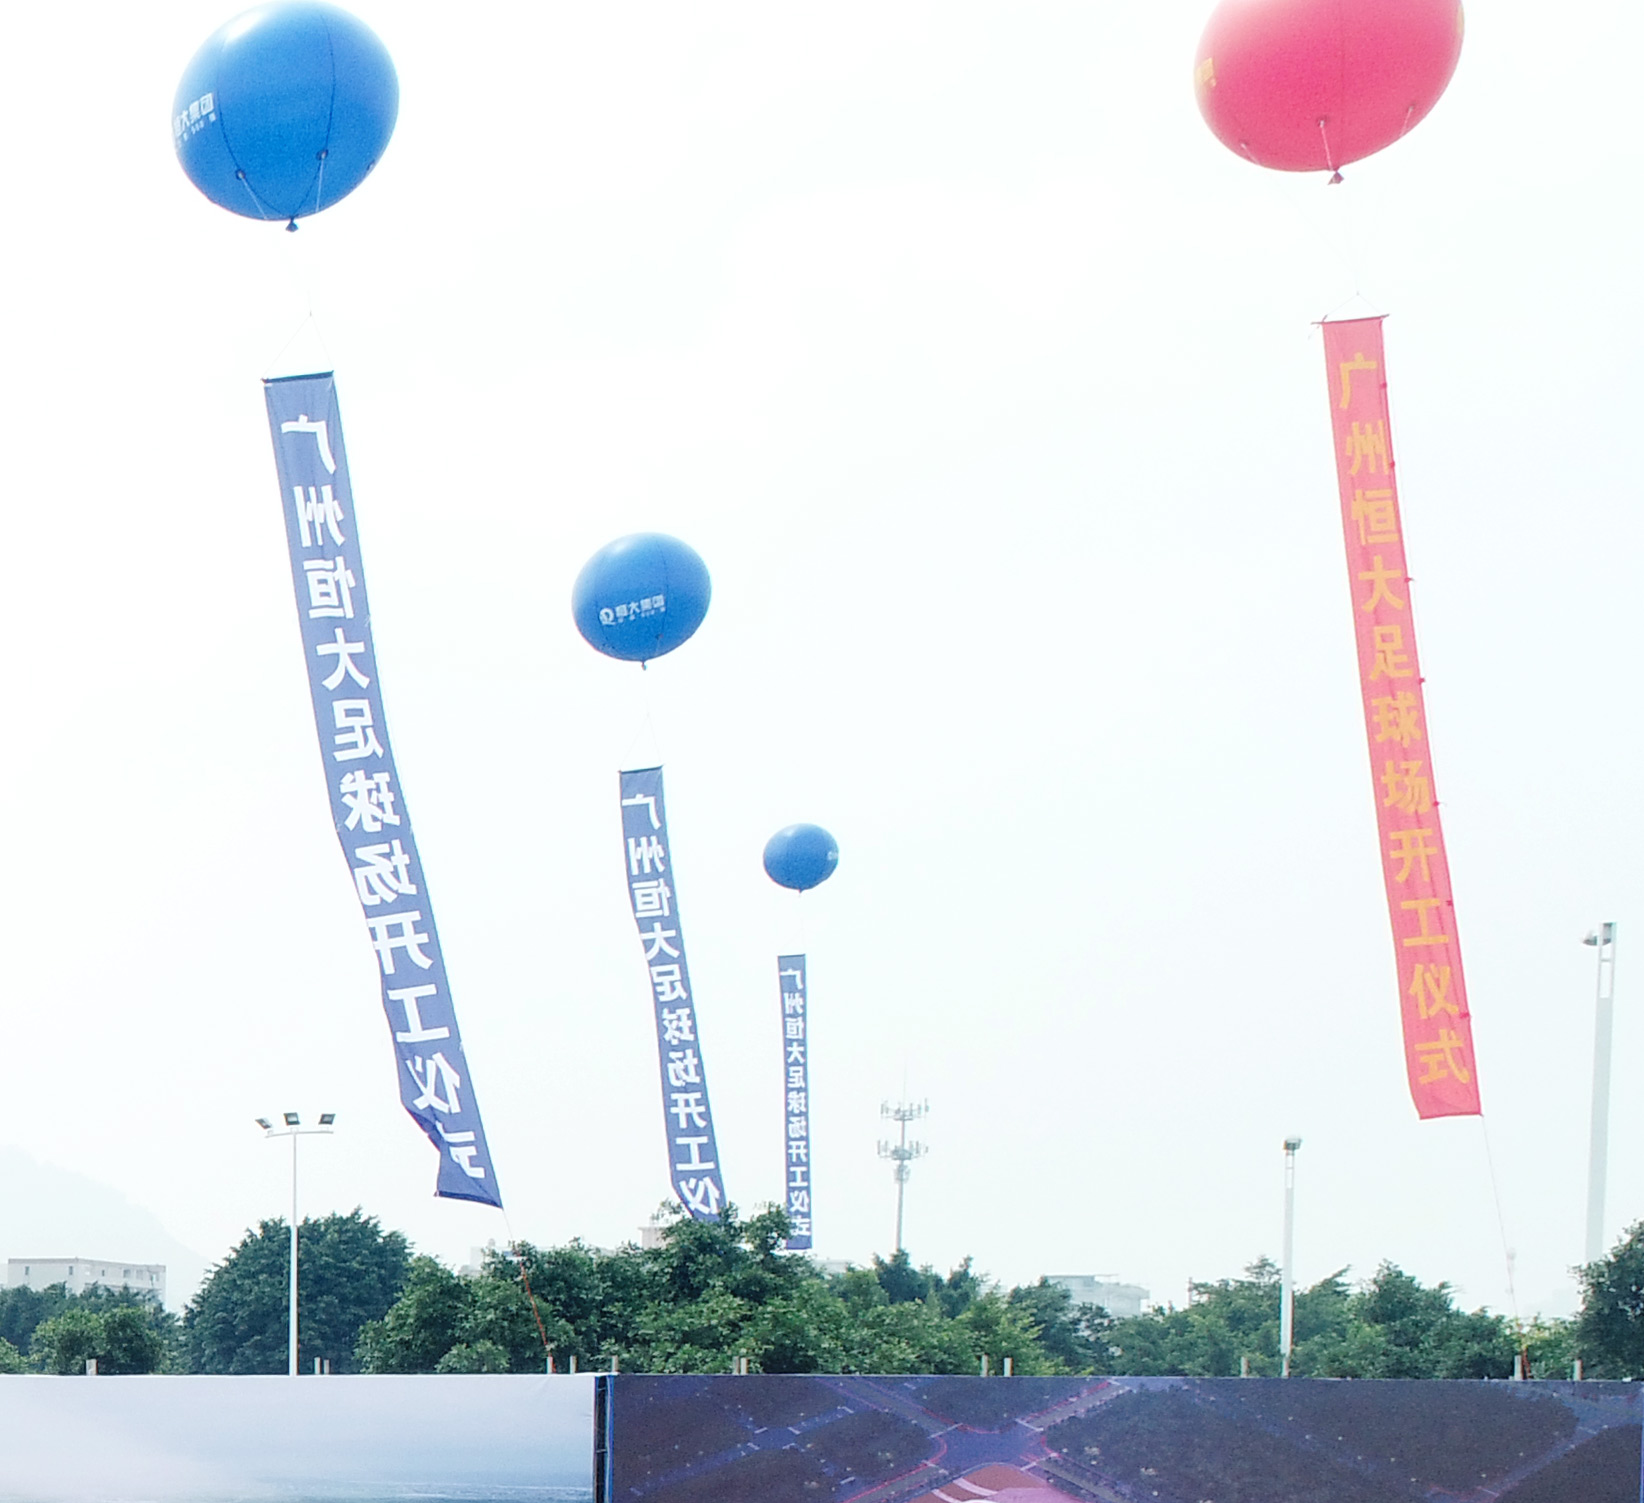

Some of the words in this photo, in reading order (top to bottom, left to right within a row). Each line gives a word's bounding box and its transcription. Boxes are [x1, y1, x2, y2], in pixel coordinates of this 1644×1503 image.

[1338, 352, 1470, 1085] 广州恒大足球场开工仪式
